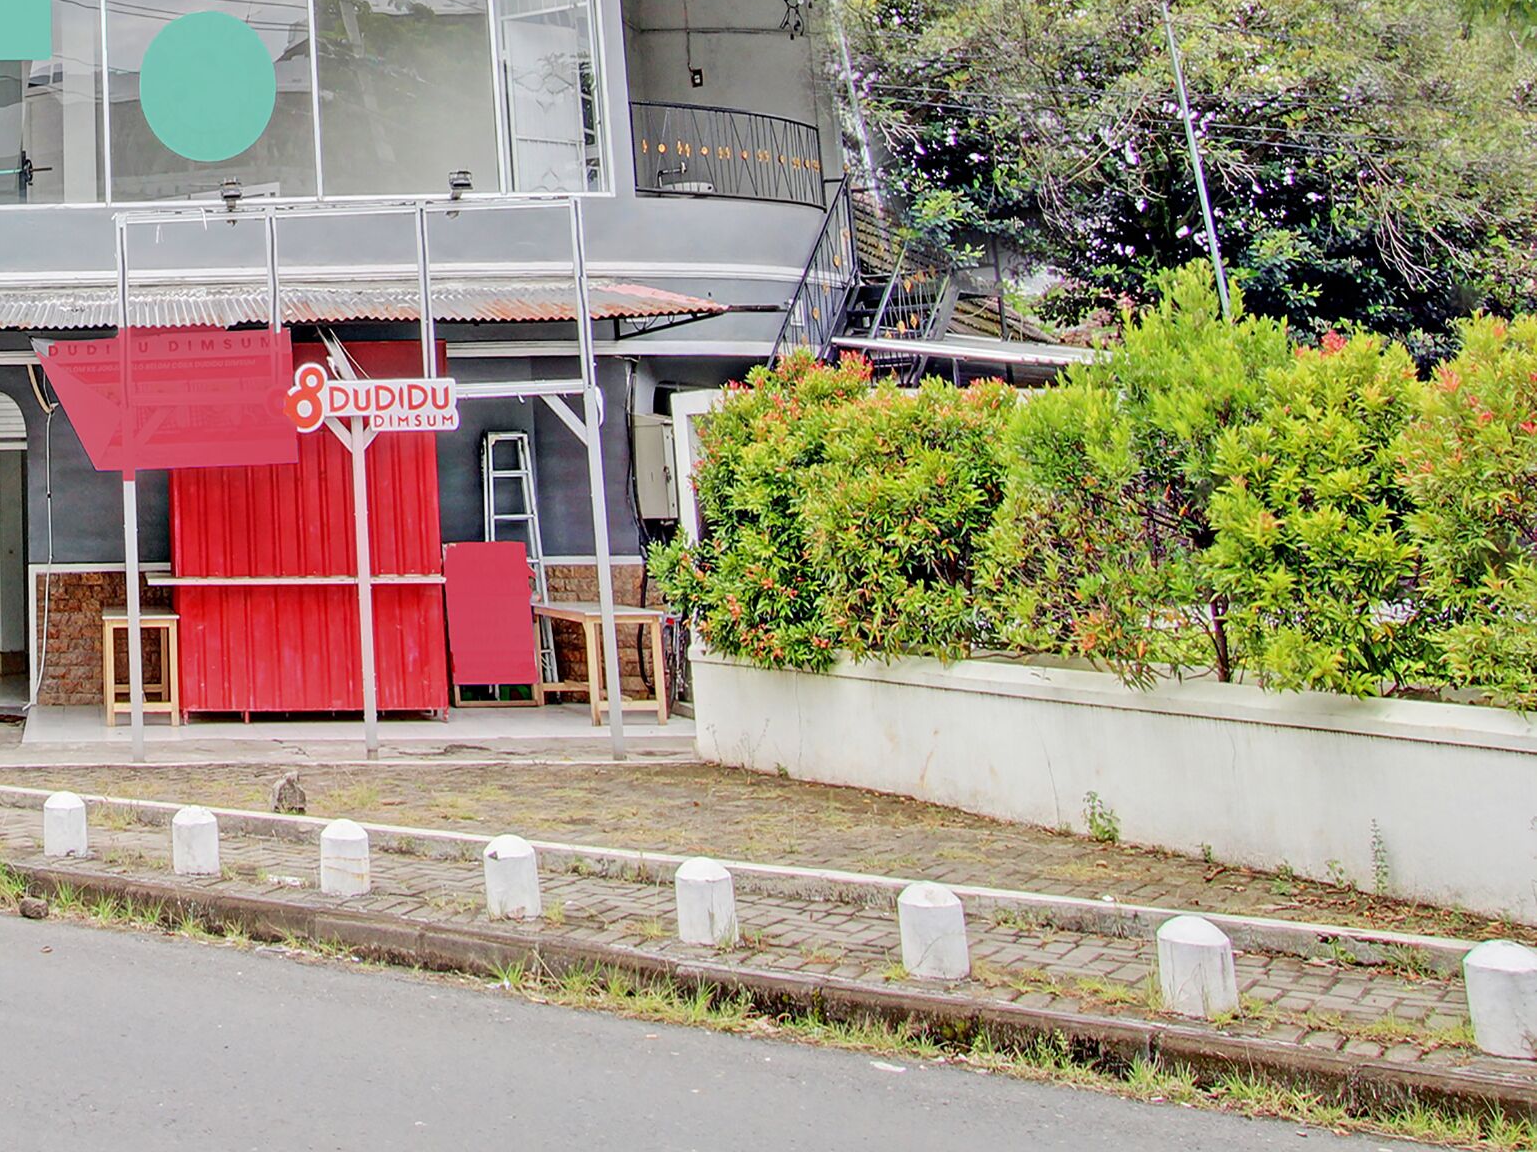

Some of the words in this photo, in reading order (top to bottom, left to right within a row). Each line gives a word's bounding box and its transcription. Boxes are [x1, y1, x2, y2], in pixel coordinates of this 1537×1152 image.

[48, 341, 148, 357] DUDIU
[329, 383, 450, 413] DUDIDU
[373, 413, 454, 428] DIMSUM
